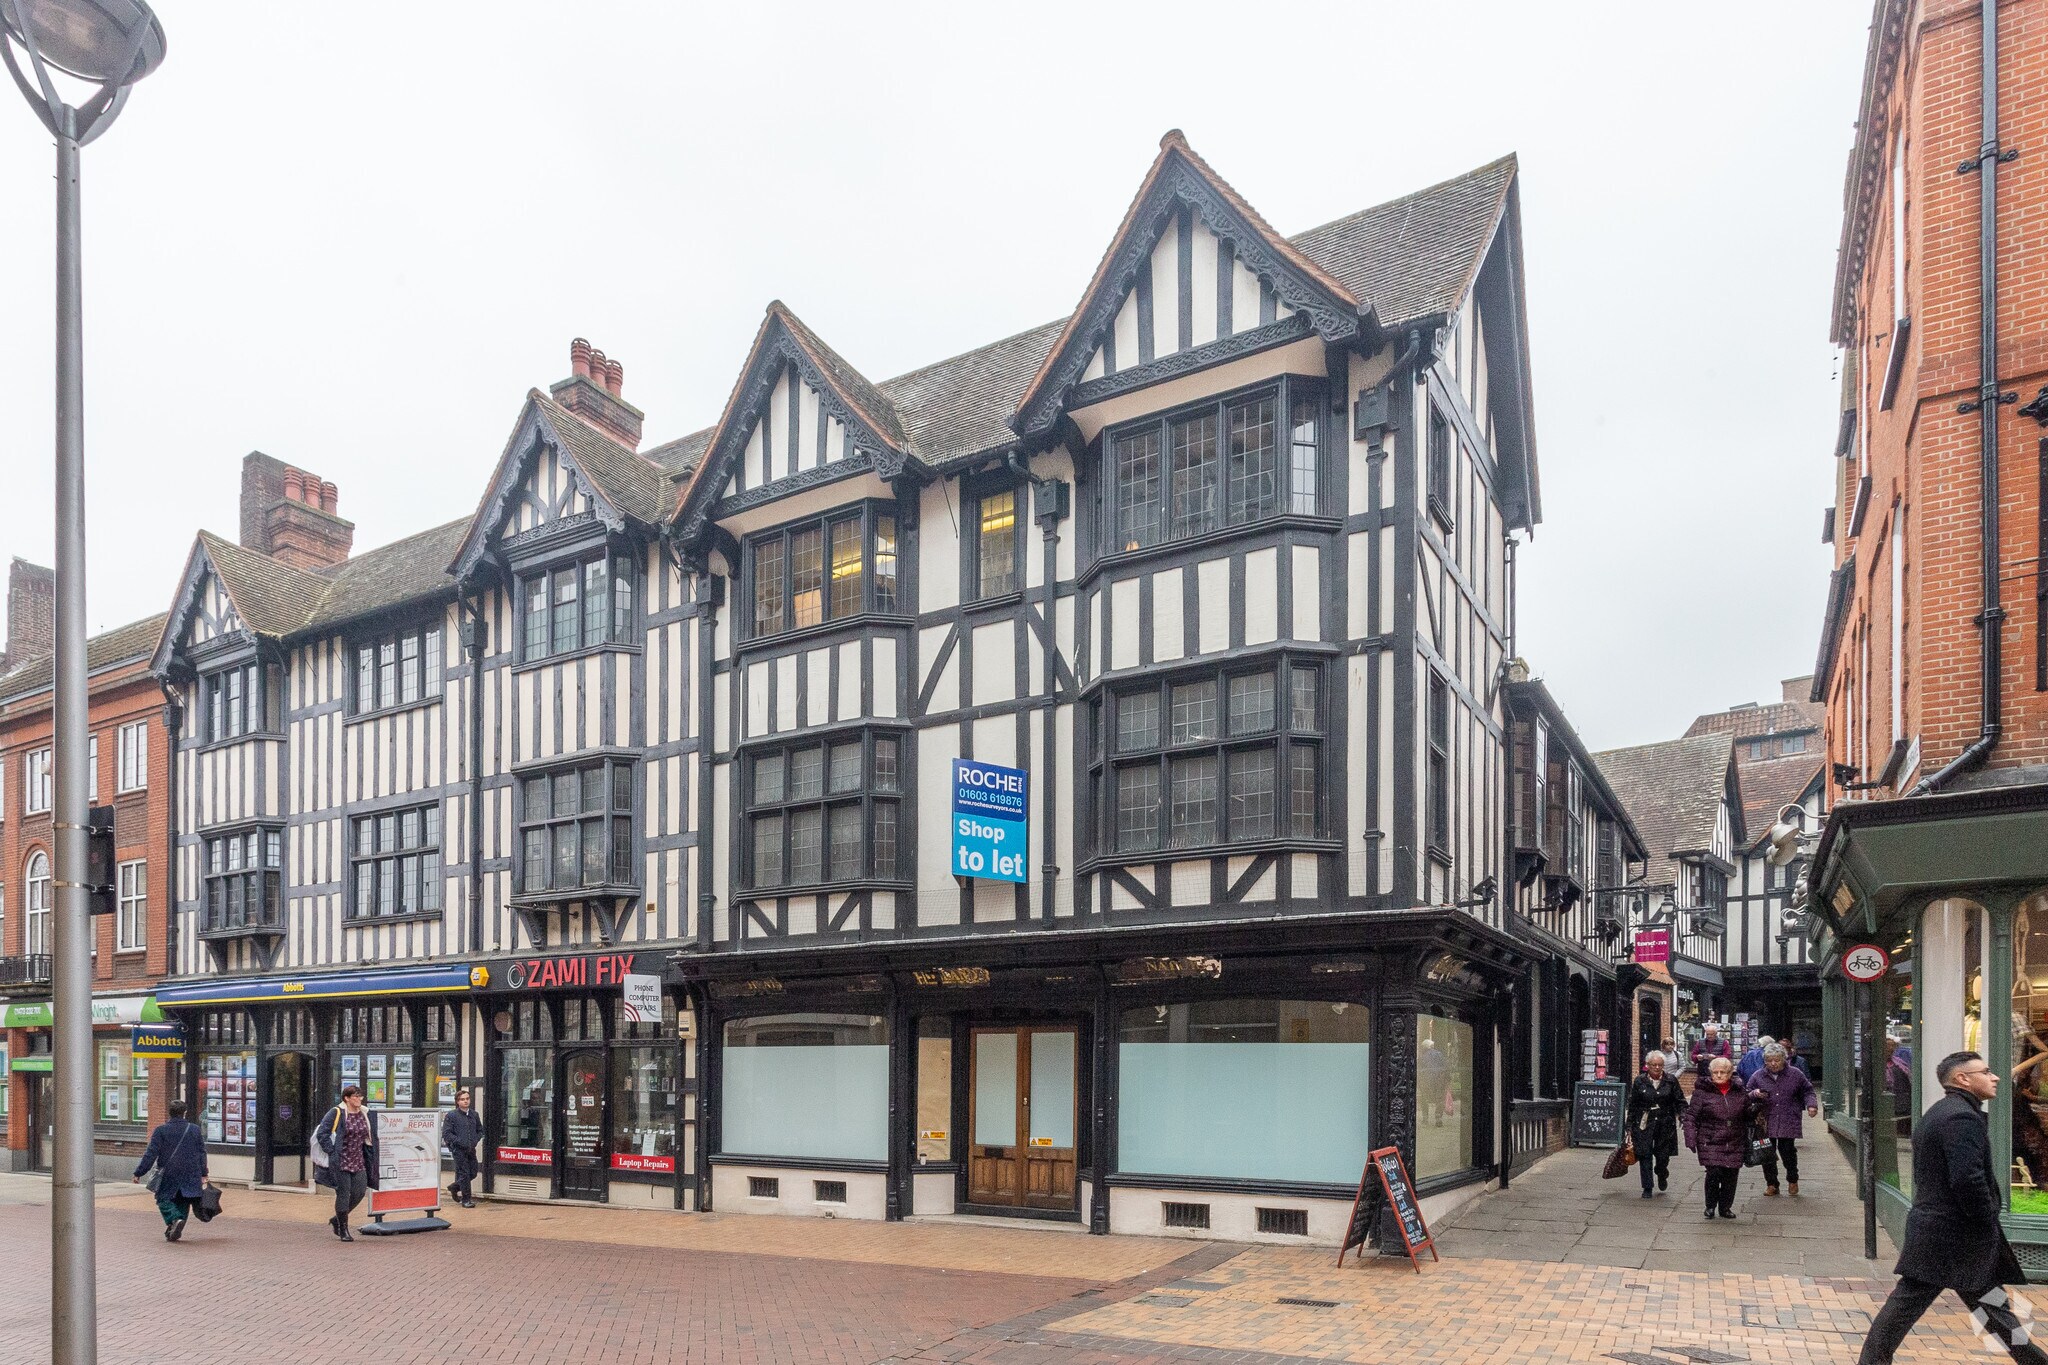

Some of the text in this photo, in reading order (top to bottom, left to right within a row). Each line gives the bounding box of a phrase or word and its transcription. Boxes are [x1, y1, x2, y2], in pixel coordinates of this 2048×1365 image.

[959, 767, 1017, 792] ROCHE
[960, 788, 1022, 806] 01603 619876
[959, 820, 1005, 844] Shop
[959, 846, 1022, 876] to let
[528, 955, 634, 987] ZAMI FIX
[283, 982, 304, 992] Abbotts
[137, 1036, 182, 1046] Abbotts
[1586, 1098, 1610, 1106] OPEN
[500, 1151, 516, 1159] Water
[518, 1152, 540, 1162] Damage
[619, 1158, 669, 1169] Laptop Repairs
